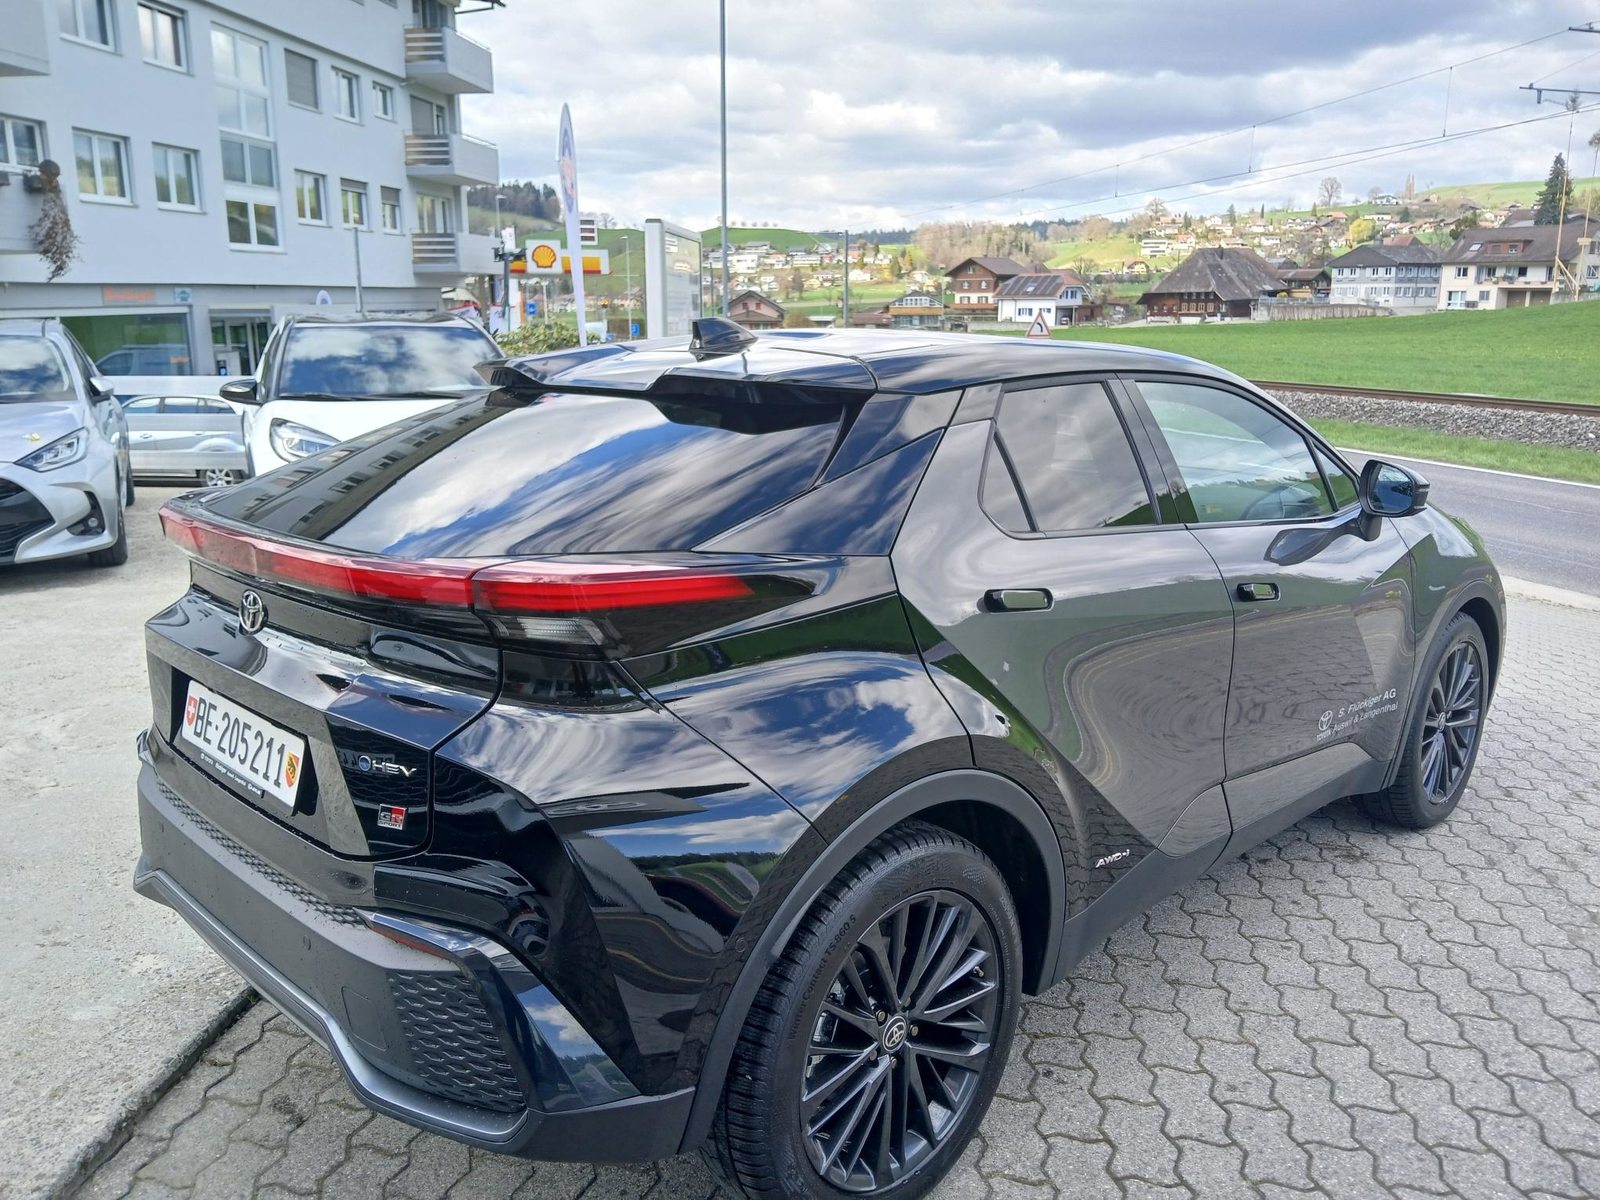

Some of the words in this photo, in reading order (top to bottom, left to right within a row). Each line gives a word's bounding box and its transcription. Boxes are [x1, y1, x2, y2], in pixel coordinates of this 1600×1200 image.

[1383, 688, 1396, 701] AG
[1360, 701, 1399, 720] Langenthal
[372, 760, 417, 777] HEV
[380, 811, 404, 825] GR
